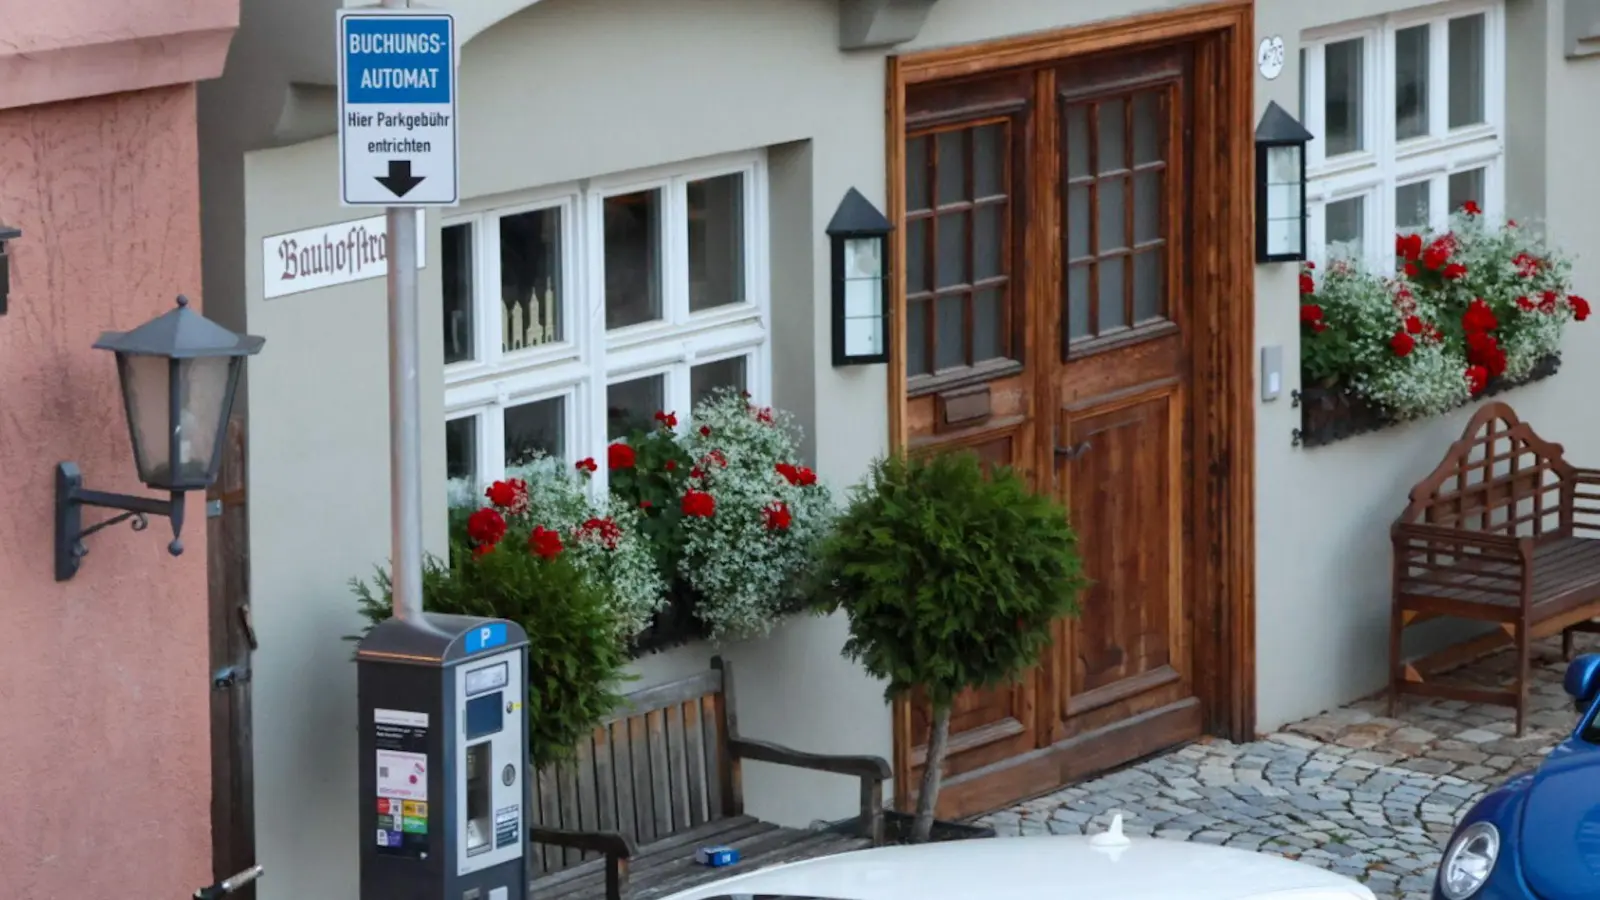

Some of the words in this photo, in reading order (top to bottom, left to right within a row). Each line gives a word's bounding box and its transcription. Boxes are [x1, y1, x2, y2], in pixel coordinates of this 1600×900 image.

[350, 33, 446, 54] BUCHUNGS-
[360, 68, 439, 89] AUTOMAT
[348, 112, 373, 127] Hier
[377, 112, 449, 131] Parkgebühr
[367, 137, 431, 153] entrichten
[278, 224, 388, 281] Bauhofstra
[480, 627, 490, 648] P
